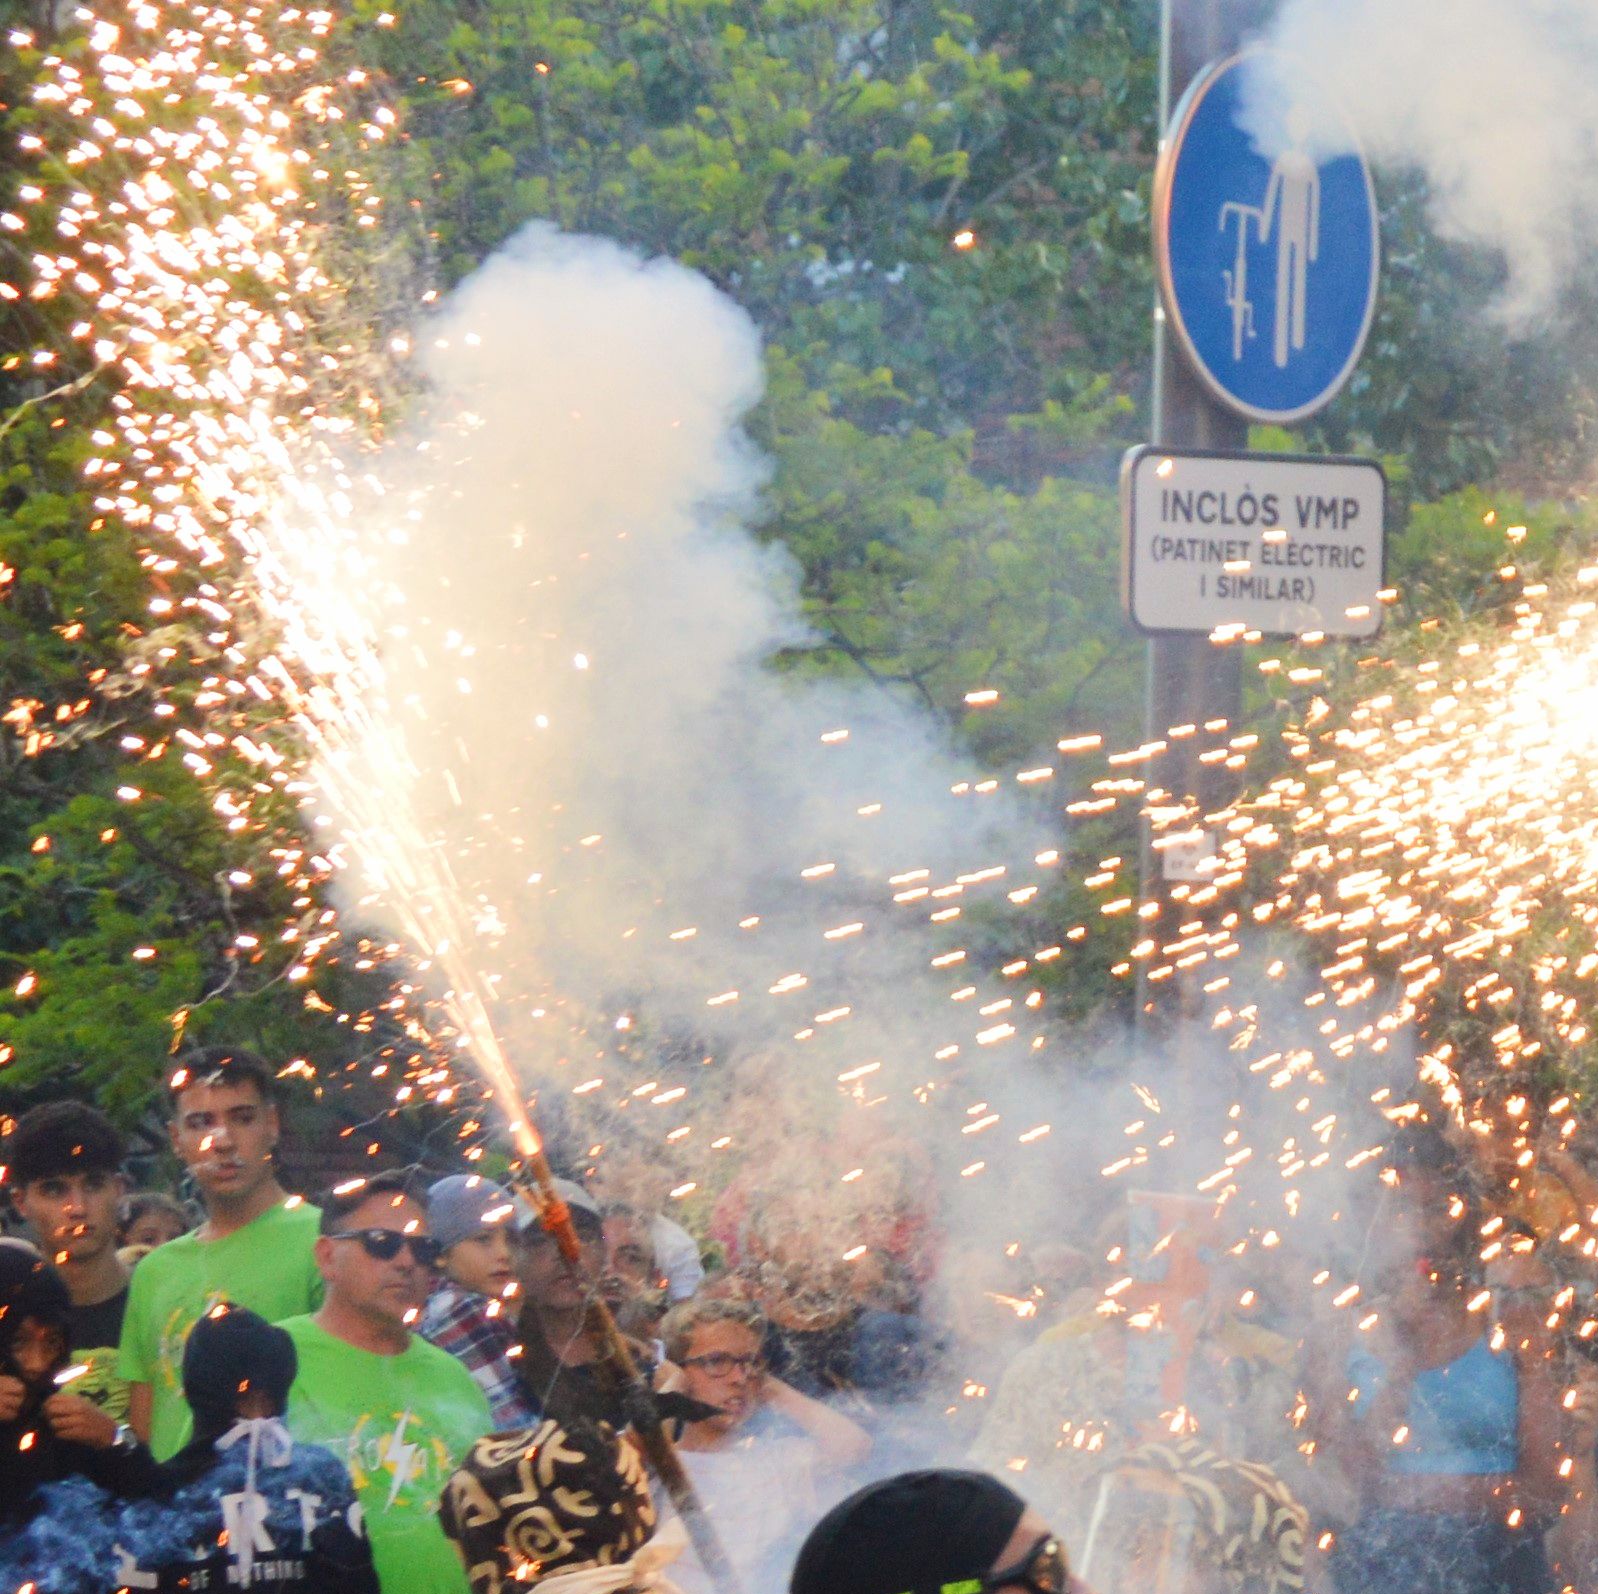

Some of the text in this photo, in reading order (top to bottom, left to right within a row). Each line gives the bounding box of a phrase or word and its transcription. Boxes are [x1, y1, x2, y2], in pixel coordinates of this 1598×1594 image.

[1161, 484, 1361, 529] INCLÒS VMP
[1152, 535, 1365, 568] (PATINET ELÈCTRIC
[1200, 574, 1315, 602] I SIMILAR)
[226, 1560, 305, 1584] NTHING
